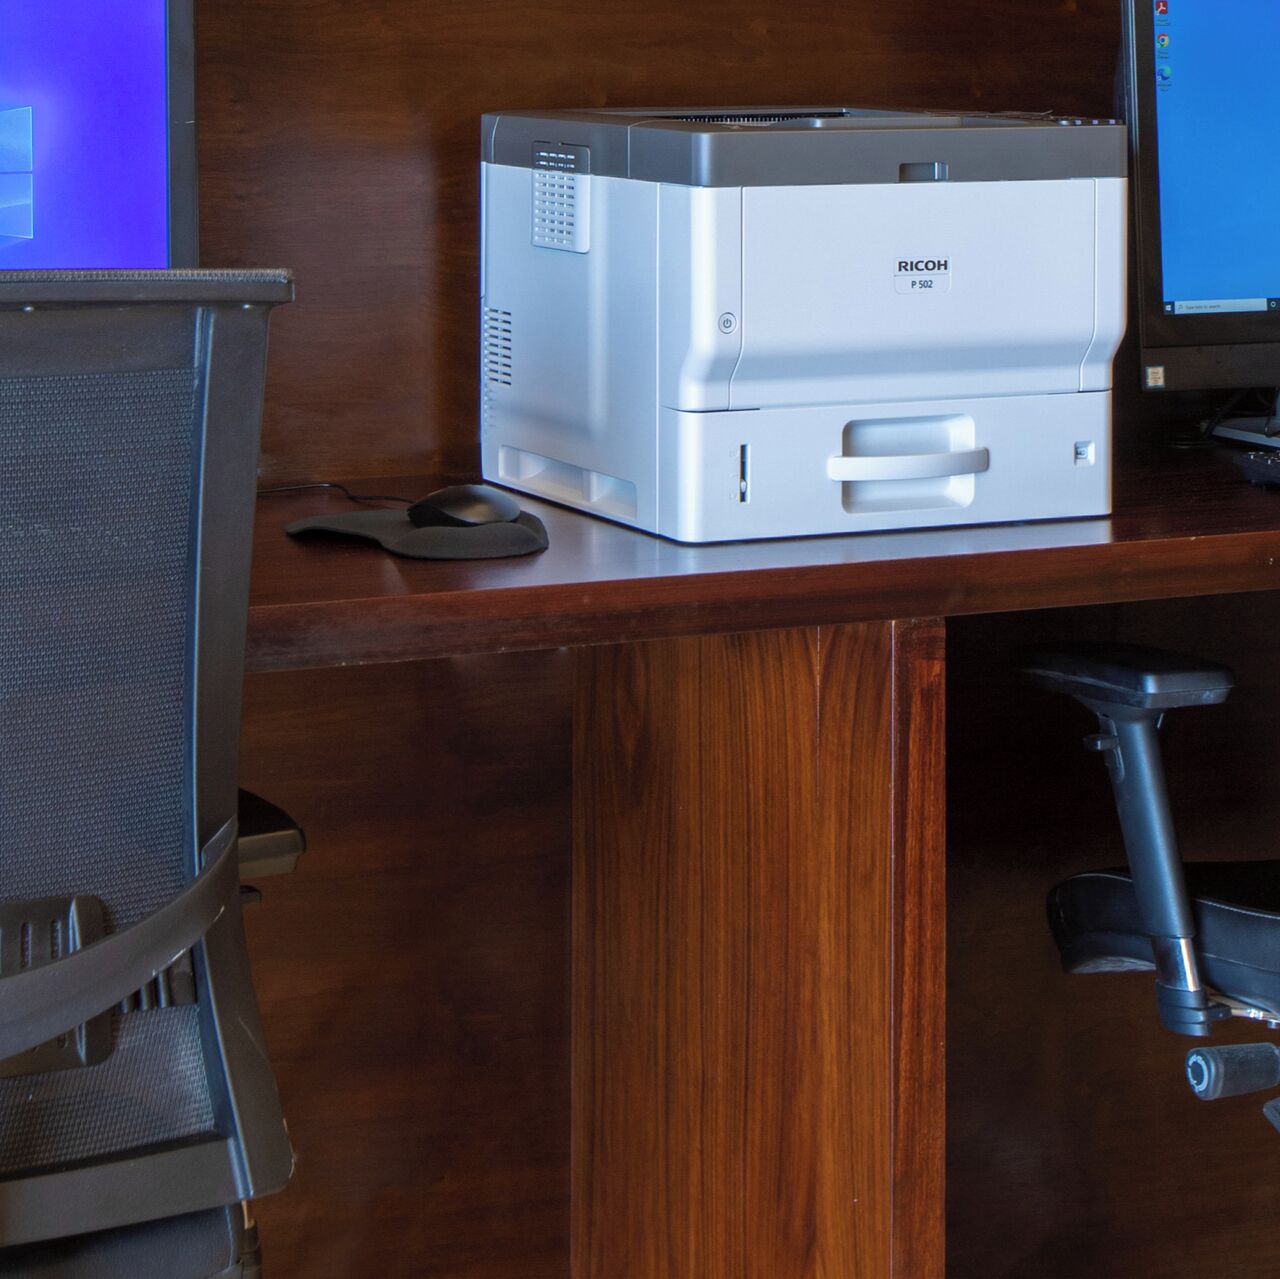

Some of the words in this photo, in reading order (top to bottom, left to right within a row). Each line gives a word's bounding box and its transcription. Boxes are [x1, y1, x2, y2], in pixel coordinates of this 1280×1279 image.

[898, 260, 948, 272] RICOH
[911, 280, 918, 289] P
[919, 280, 933, 289] 502
